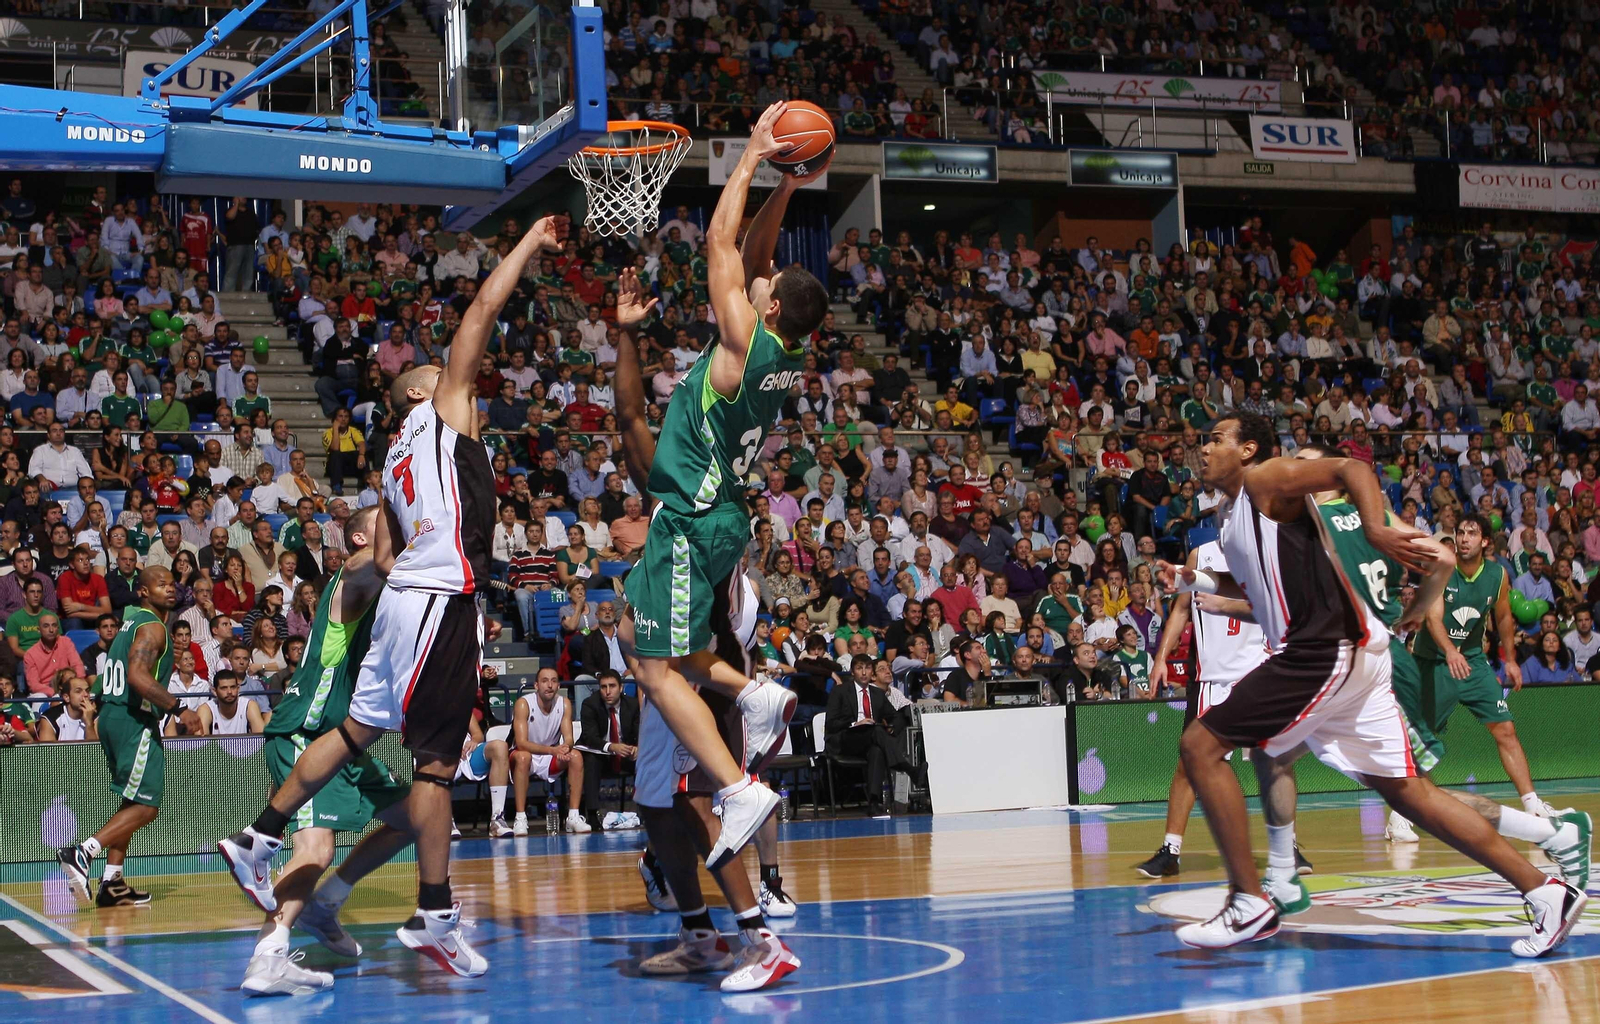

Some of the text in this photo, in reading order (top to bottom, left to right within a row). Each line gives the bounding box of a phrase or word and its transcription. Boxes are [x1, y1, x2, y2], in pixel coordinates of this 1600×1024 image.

[143, 63, 235, 93] SUR
[67, 125, 146, 144] MONDO
[1262, 123, 1342, 147] SUR
[299, 154, 372, 173] MONDO
[934, 162, 981, 178] Unicaja
[1245, 164, 1272, 174] SALIDA
[1119, 169, 1163, 184] Unicaja
[1464, 168, 1552, 190] Corvina
[732, 425, 765, 477] 3
[392, 453, 415, 507] 7
[103, 658, 125, 697] 00
